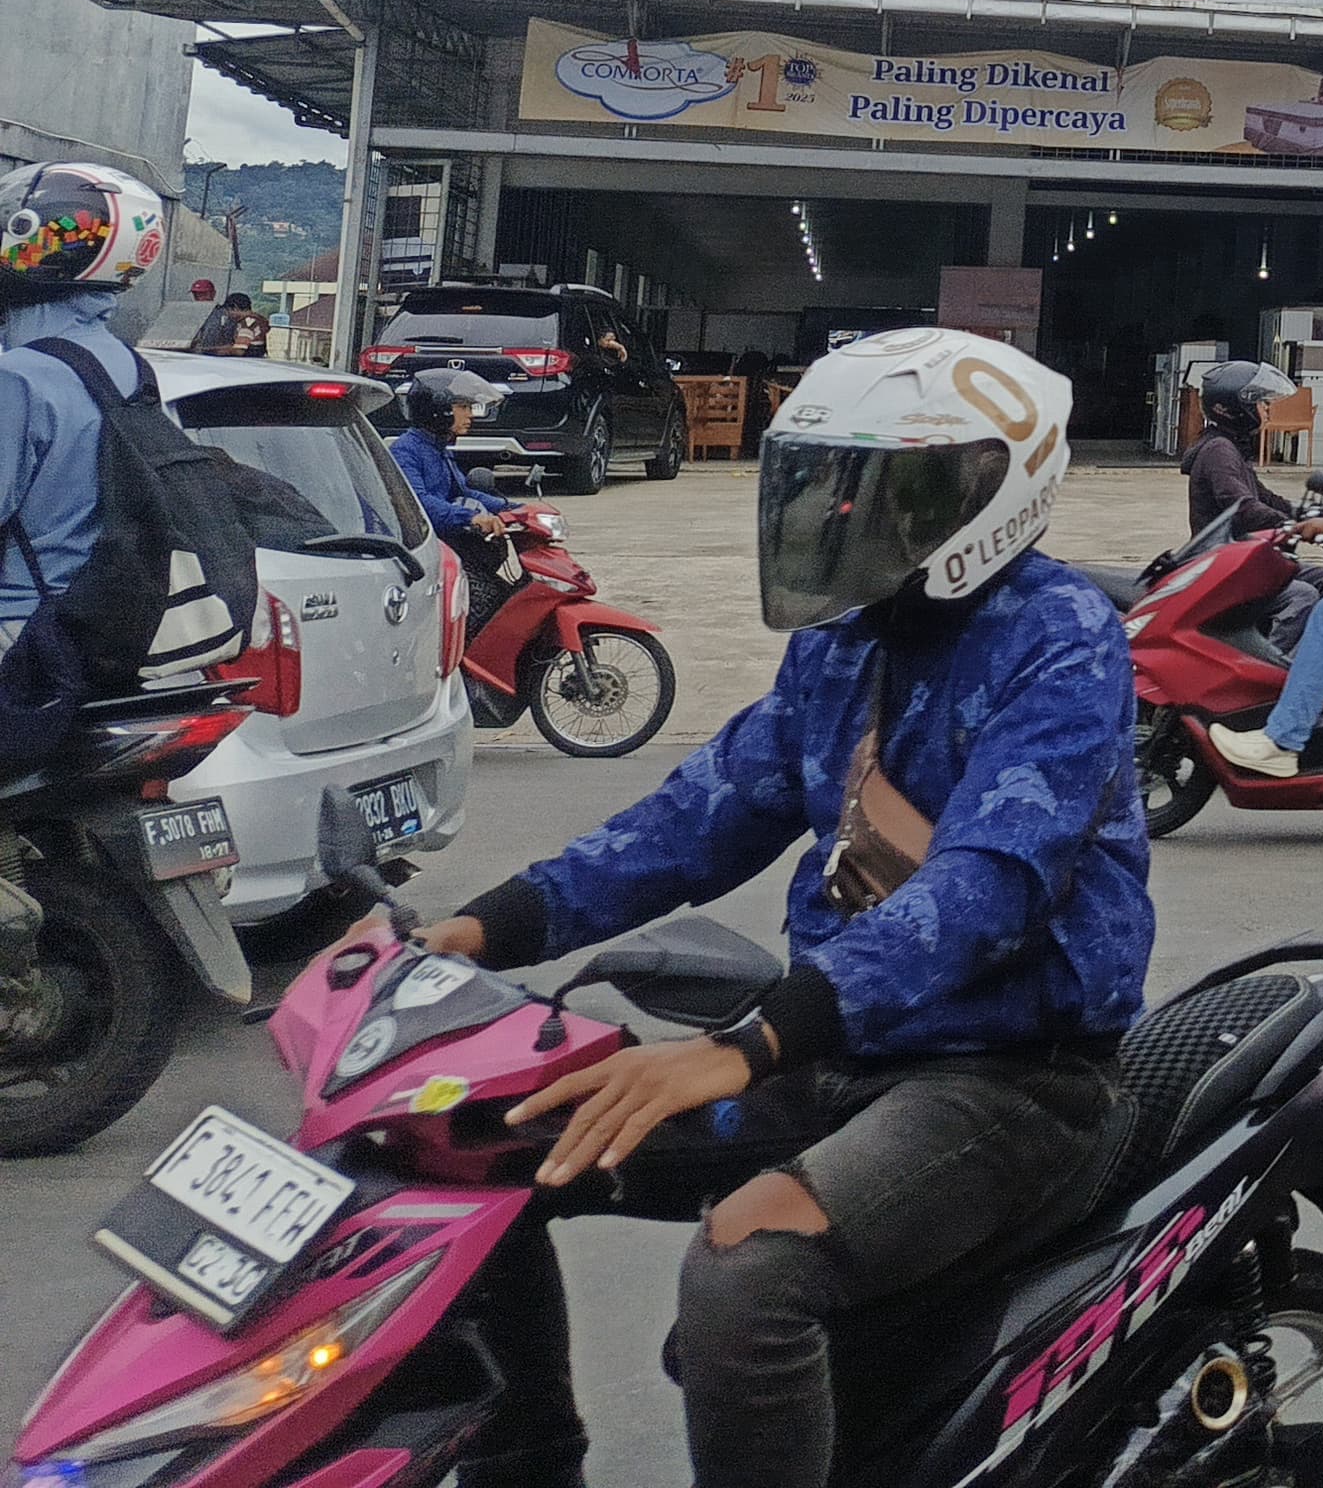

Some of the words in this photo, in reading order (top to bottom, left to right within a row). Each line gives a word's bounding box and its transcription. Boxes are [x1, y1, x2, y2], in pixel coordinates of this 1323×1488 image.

[581, 62, 700, 83] COMORTA
[871, 59, 979, 92] Paling
[985, 63, 1110, 93] Dikenal
[849, 94, 954, 129] Paling
[963, 100, 1126, 135] Dipercaya
